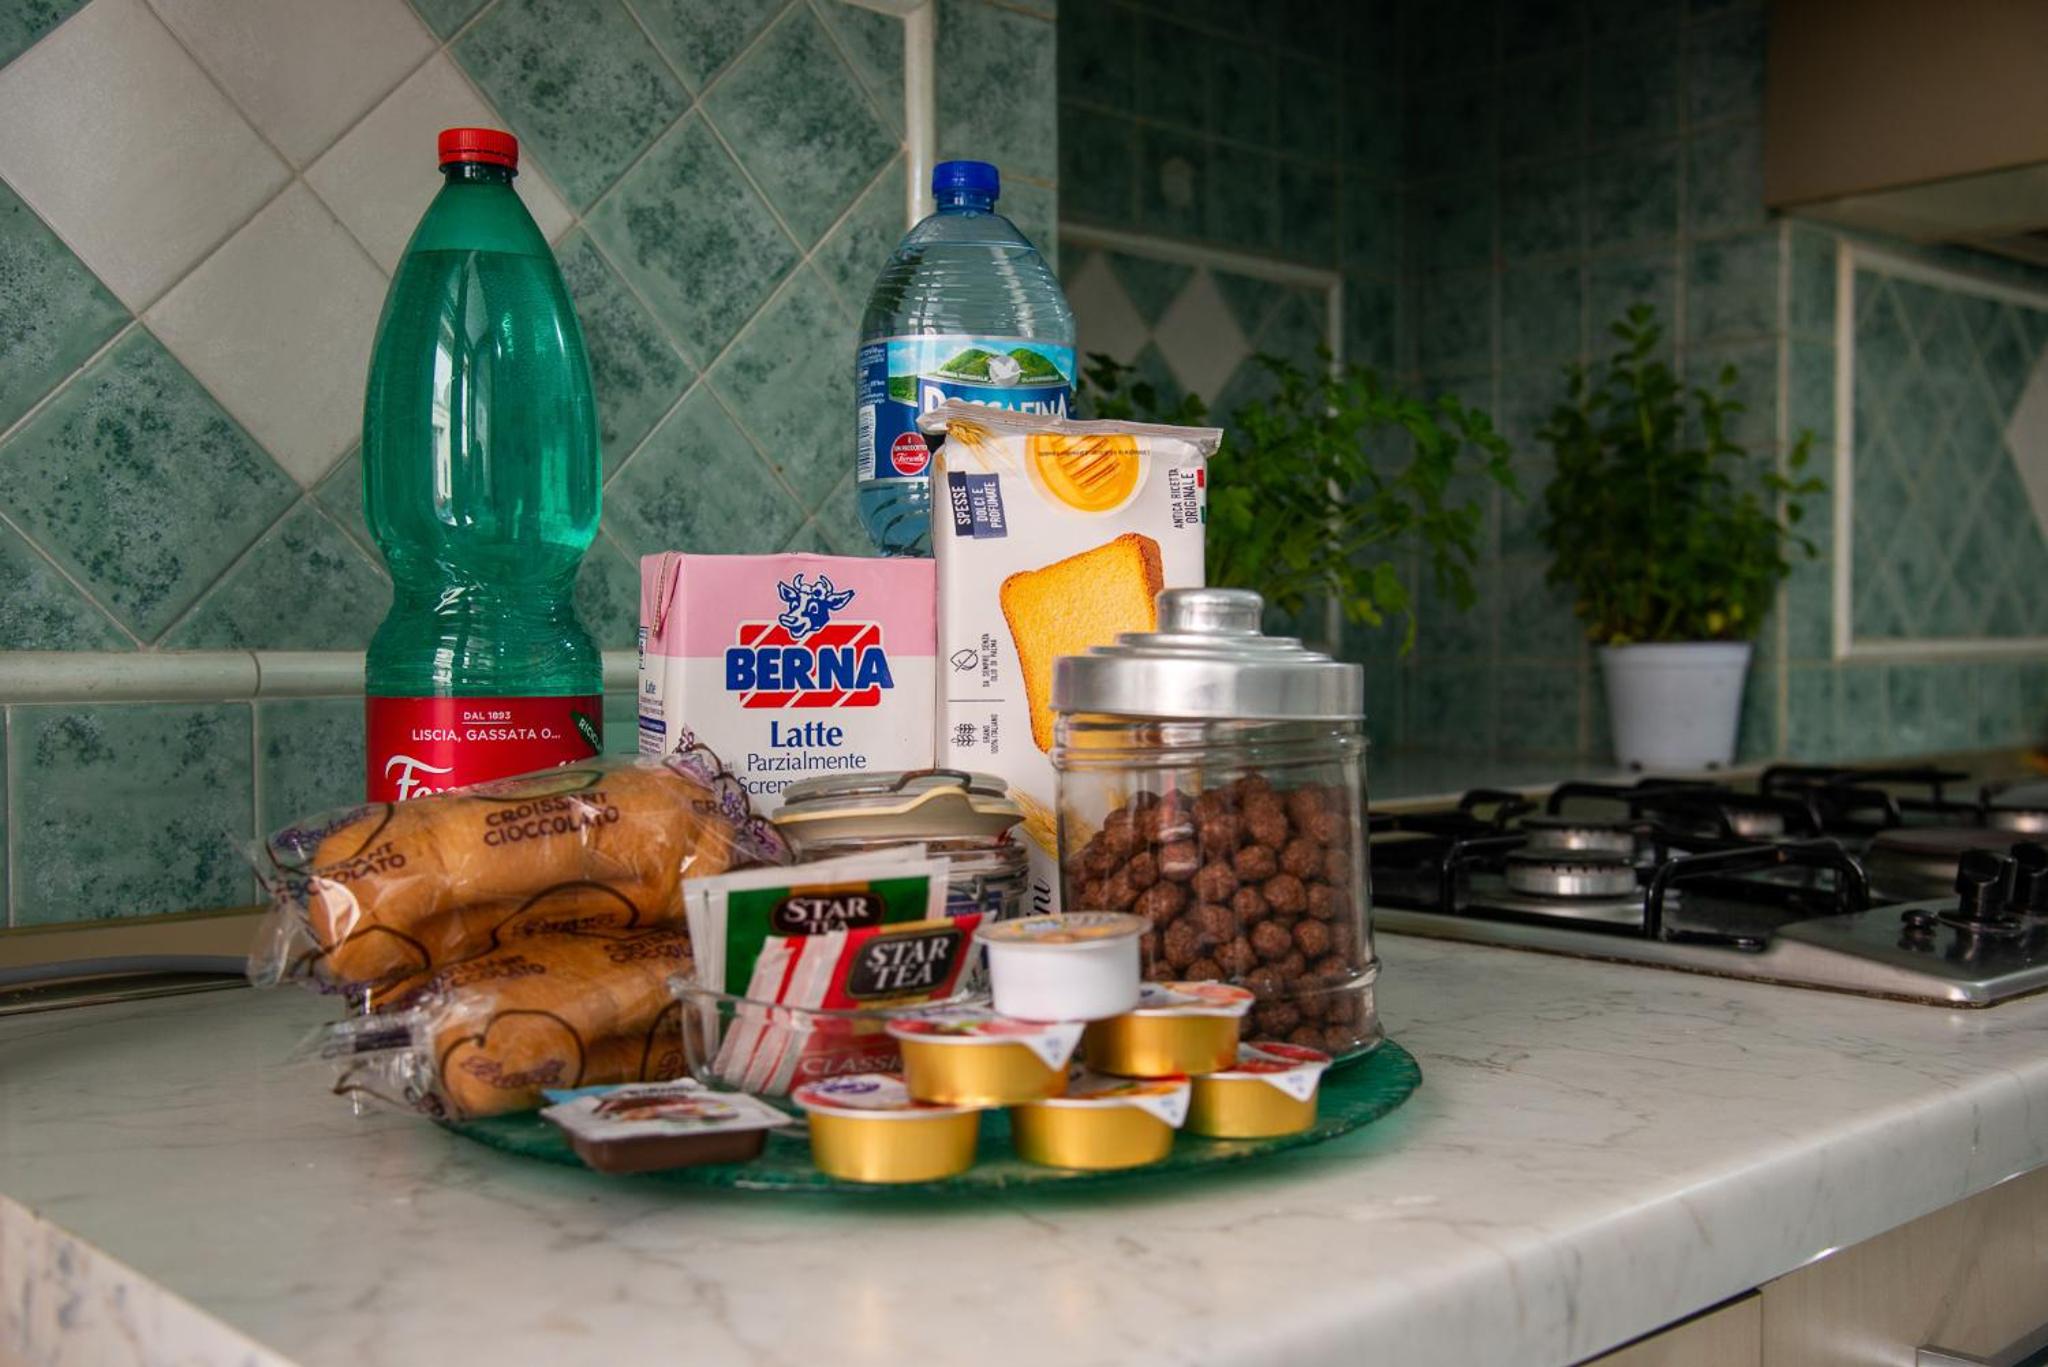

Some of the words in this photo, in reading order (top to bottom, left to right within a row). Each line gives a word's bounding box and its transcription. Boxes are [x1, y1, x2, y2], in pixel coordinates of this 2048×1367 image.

[1168, 468, 1181, 498] RICETTA
[951, 485, 971, 525] SPESSE
[972, 496, 988, 522] DOLCI
[984, 481, 1002, 528] PROFUMATE
[1181, 473, 1198, 524] ORIGINALE
[1172, 502, 1184, 529] ANTICA
[725, 646, 895, 691] BERNA
[463, 711, 485, 720] DAL
[488, 710, 511, 720] 1893
[412, 728, 461, 743] LISCIA,
[466, 728, 537, 741] GASSATA
[770, 720, 843, 748] Latte
[746, 751, 867, 773] Parzialmente
[784, 897, 869, 923] STAR
[865, 937, 950, 970] STAR
[872, 961, 933, 990] TEA
